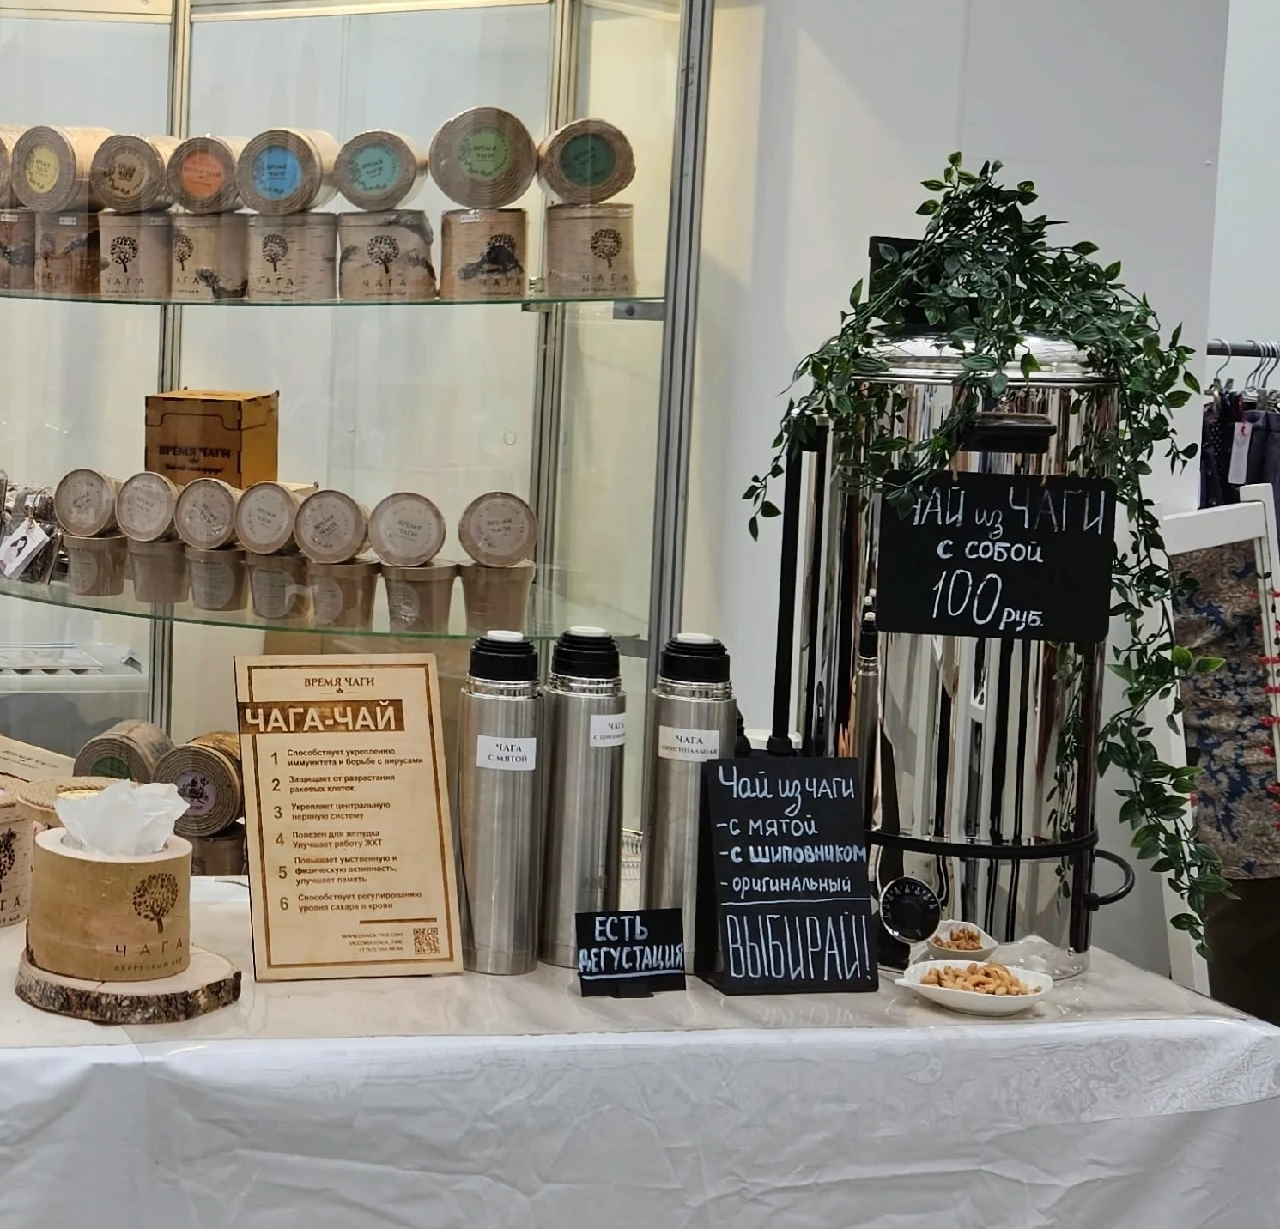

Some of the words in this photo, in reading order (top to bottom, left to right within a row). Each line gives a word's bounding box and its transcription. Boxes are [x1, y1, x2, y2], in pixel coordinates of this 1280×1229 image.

[1009, 486, 1105, 535] ЧАГИ
[932, 569, 1003, 625] 100
[304, 677, 342, 687] ВРЕМЯ
[344, 676, 374, 687] ЧАГИ
[245, 700, 396, 733] ЧАГА-ЧАЙ
[676, 734, 704, 745] ЧАГА
[495, 743, 522, 754] ЧАГА
[270, 752, 278, 766] 1
[271, 778, 281, 792] 2
[778, 779, 803, 816] из
[274, 806, 283, 819] 3
[275, 832, 285, 846] 4
[278, 866, 288, 880] 5
[280, 897, 289, 911] 6
[594, 915, 649, 942] ЕСТЬ
[116, 937, 183, 957] ЧАГА
[726, 911, 872, 981] ВЫБИРАЙ!
[579, 943, 683, 973] ДЕГУСТАЦИЯ
